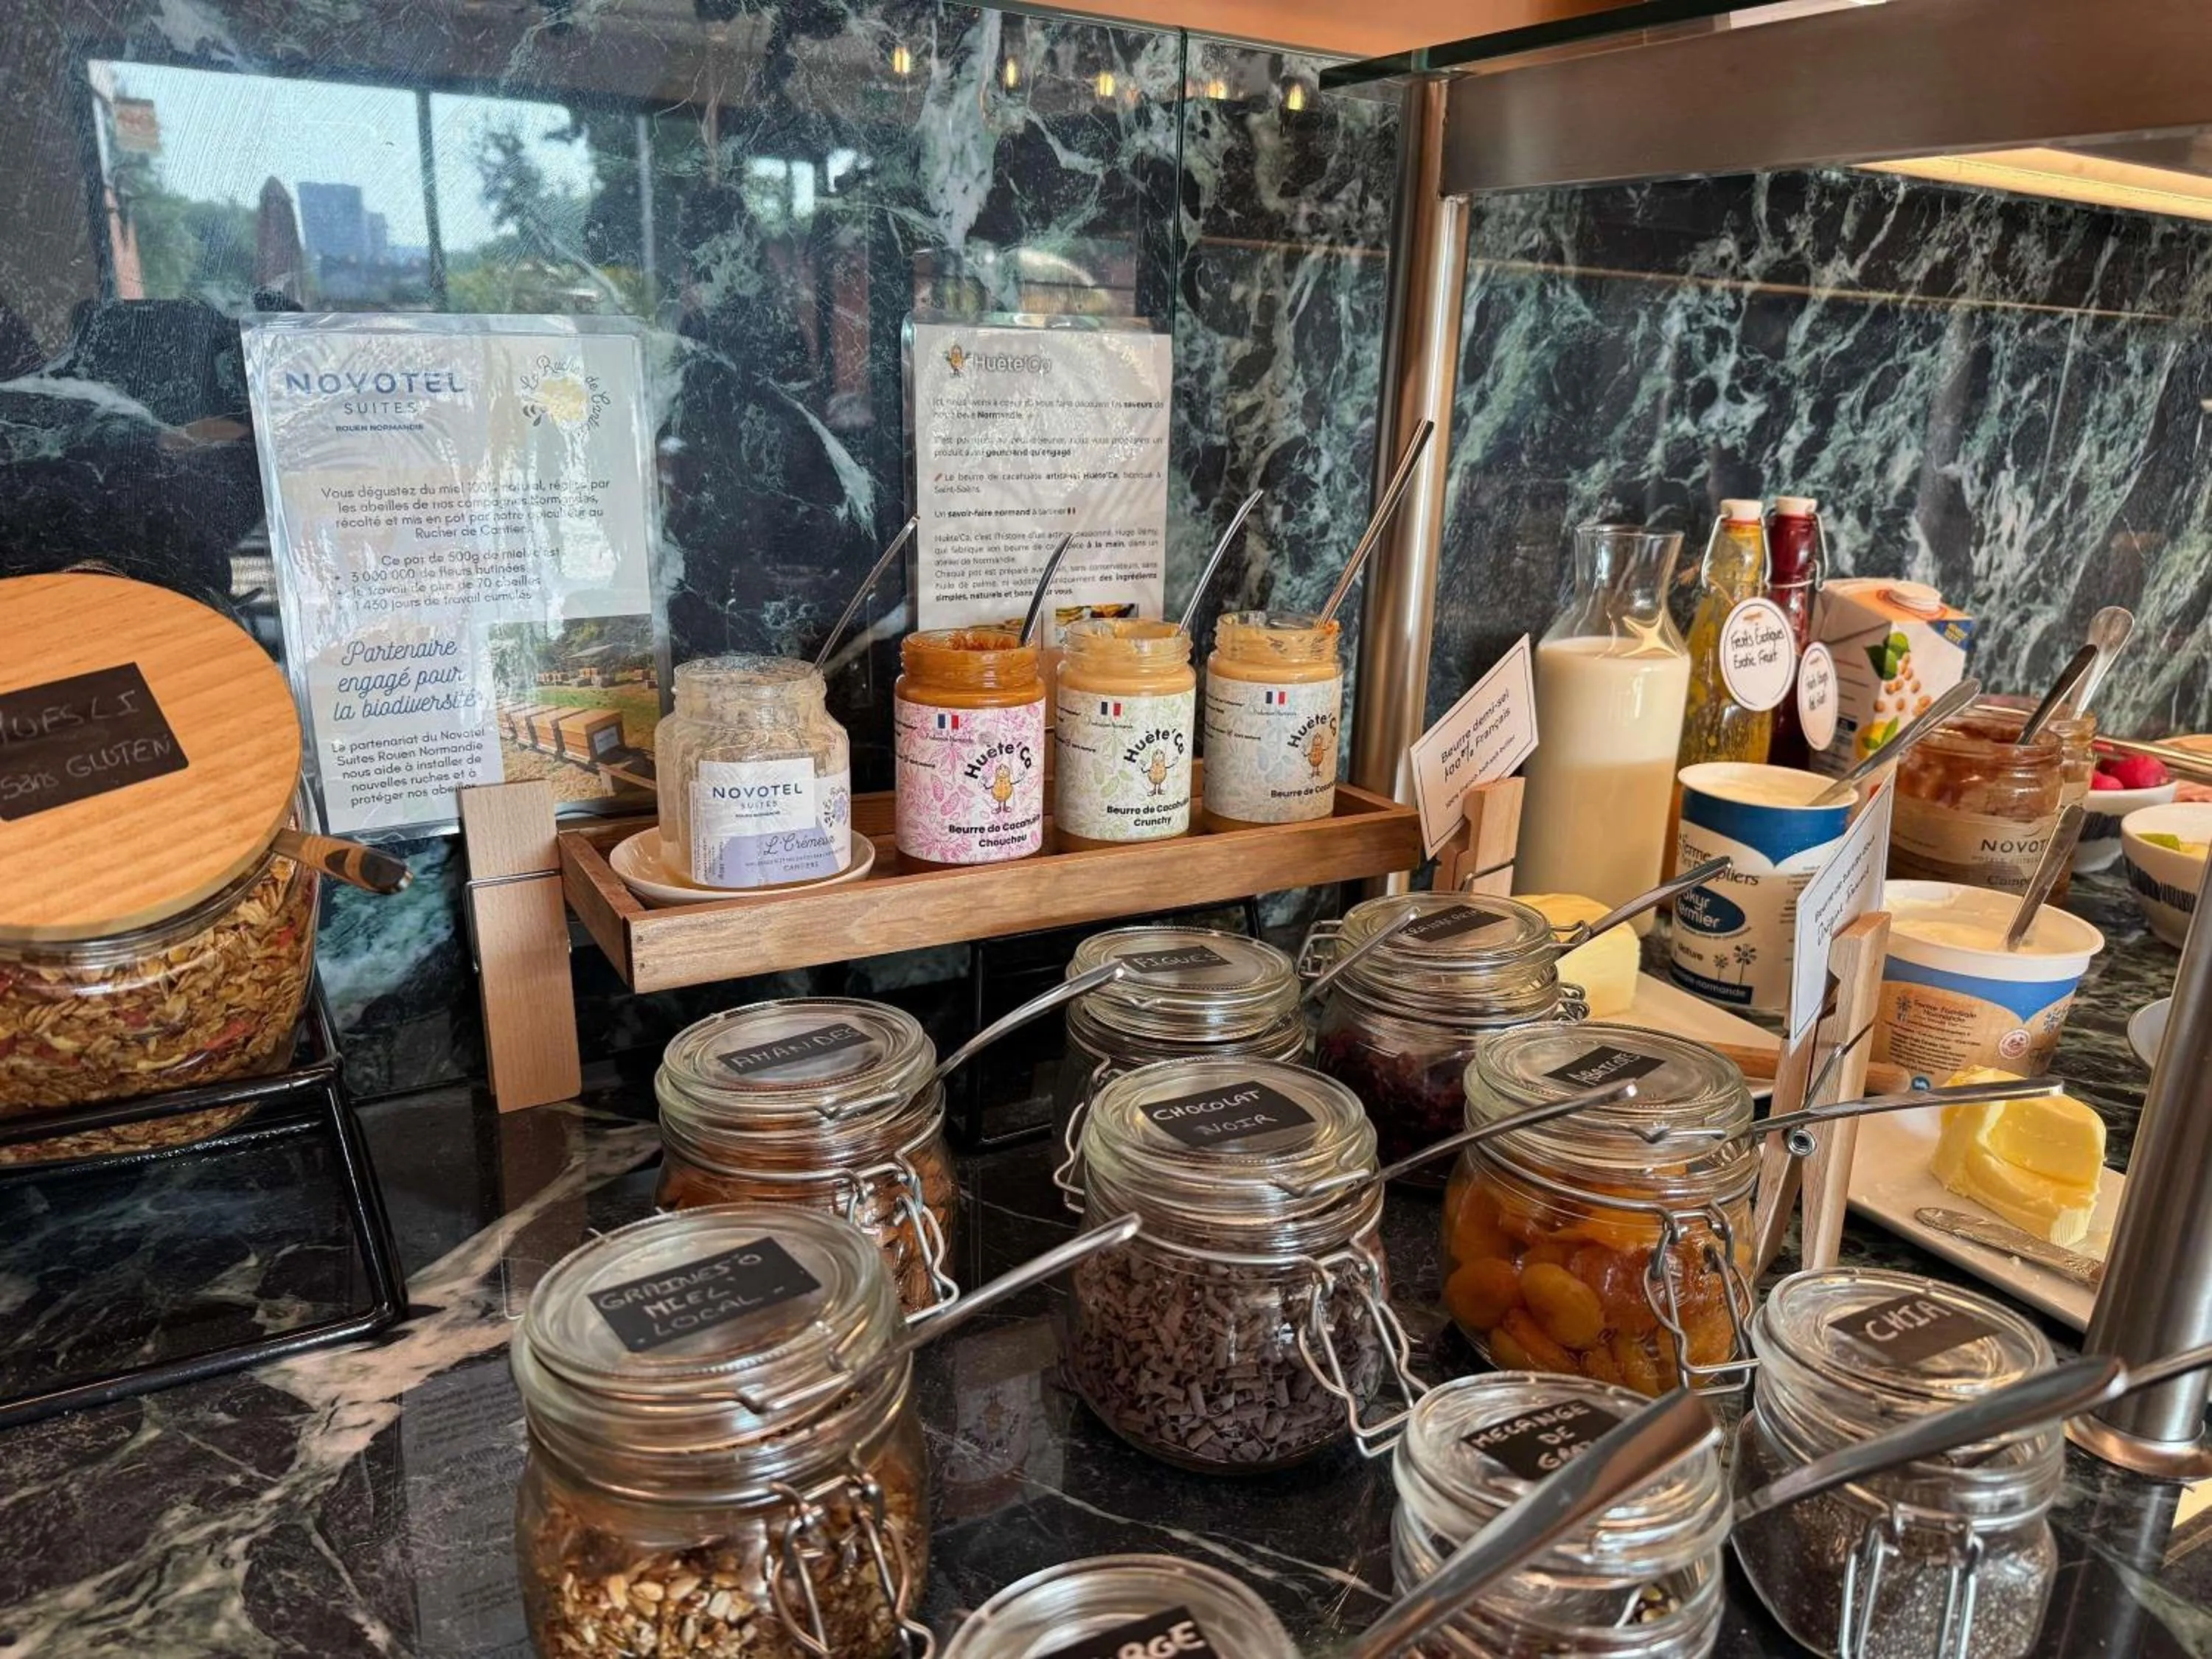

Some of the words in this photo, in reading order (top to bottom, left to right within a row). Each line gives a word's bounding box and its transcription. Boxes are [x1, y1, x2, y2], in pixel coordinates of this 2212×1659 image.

[286, 372, 465, 394] NOVOTEL
[344, 402, 418, 414] SUITES
[335, 425, 368, 433] ROUEN
[321, 487, 354, 499] Vous
[358, 484, 417, 500] dégustez
[420, 484, 436, 495] du
[439, 482, 464, 494] miel
[591, 480, 610, 492] par
[338, 502, 357, 514] les
[361, 499, 409, 512] abeilles
[413, 498, 428, 509] de
[433, 500, 454, 509] nos
[336, 516, 381, 529] récolté
[386, 516, 397, 526] et
[402, 515, 422, 525] mis
[426, 515, 442, 524] en
[445, 513, 465, 526] pot
[589, 509, 604, 517] au
[415, 527, 457, 539] Rucher
[462, 526, 476, 536] de
[381, 555, 400, 566] Ce
[404, 557, 425, 568] pot
[428, 552, 443, 563] de
[448, 550, 479, 564] 500g
[483, 549, 498, 560] de
[479, 577, 492, 588] 70
[392, 599, 421, 611] jours
[425, 596, 440, 607] de
[444, 593, 480, 605] travail
[341, 640, 457, 667] Partenaire
[338, 667, 411, 698] engagé
[414, 666, 465, 692] pour
[333, 702, 355, 721] la
[362, 689, 477, 718] biodiversité
[1475, 707, 1511, 749] Français
[350, 734, 419, 754] partenariat
[422, 732, 438, 742] du
[440, 728, 485, 740] Novotel
[1440, 728, 1472, 764] Beurre
[66, 734, 170, 777] GLUTEN
[337, 754, 375, 767] Suites
[378, 750, 415, 761] Rouen
[420, 742, 483, 757] Normandie
[964, 741, 1032, 779] Huète'Co
[342, 768, 372, 779] nous
[374, 762, 402, 775] aide
[405, 760, 414, 772] à
[417, 756, 463, 770] installer
[466, 754, 481, 765] de
[352, 778, 407, 792] nouvelles
[410, 772, 450, 785] ruches
[453, 769, 465, 780] et
[468, 768, 477, 778] à
[713, 782, 803, 799] NOVOTEL
[350, 792, 403, 808] protéger
[408, 789, 428, 799] nos
[1271, 790, 1302, 799] Beurre
[1304, 788, 1313, 796] de
[1107, 805, 1141, 815] Beurre
[1143, 805, 1155, 815] de
[949, 824, 985, 835] Beurre
[988, 823, 1001, 833] de
[1134, 816, 1172, 827] Crunchy
[978, 834, 1027, 847] Chouchou
[1980, 838, 2048, 854] NOVOT
[1152, 1088, 1262, 1122] CHOCOLAT
[1194, 1113, 1277, 1138] NOIR
[599, 1264, 731, 1310] GRAINES
[644, 1287, 731, 1319] MIEL
[654, 1295, 764, 1337] LOCAL
[1865, 1300, 1952, 1342] CHIA
[1472, 1402, 1590, 1450] MELANGE
[1537, 1426, 1575, 1444] DE
